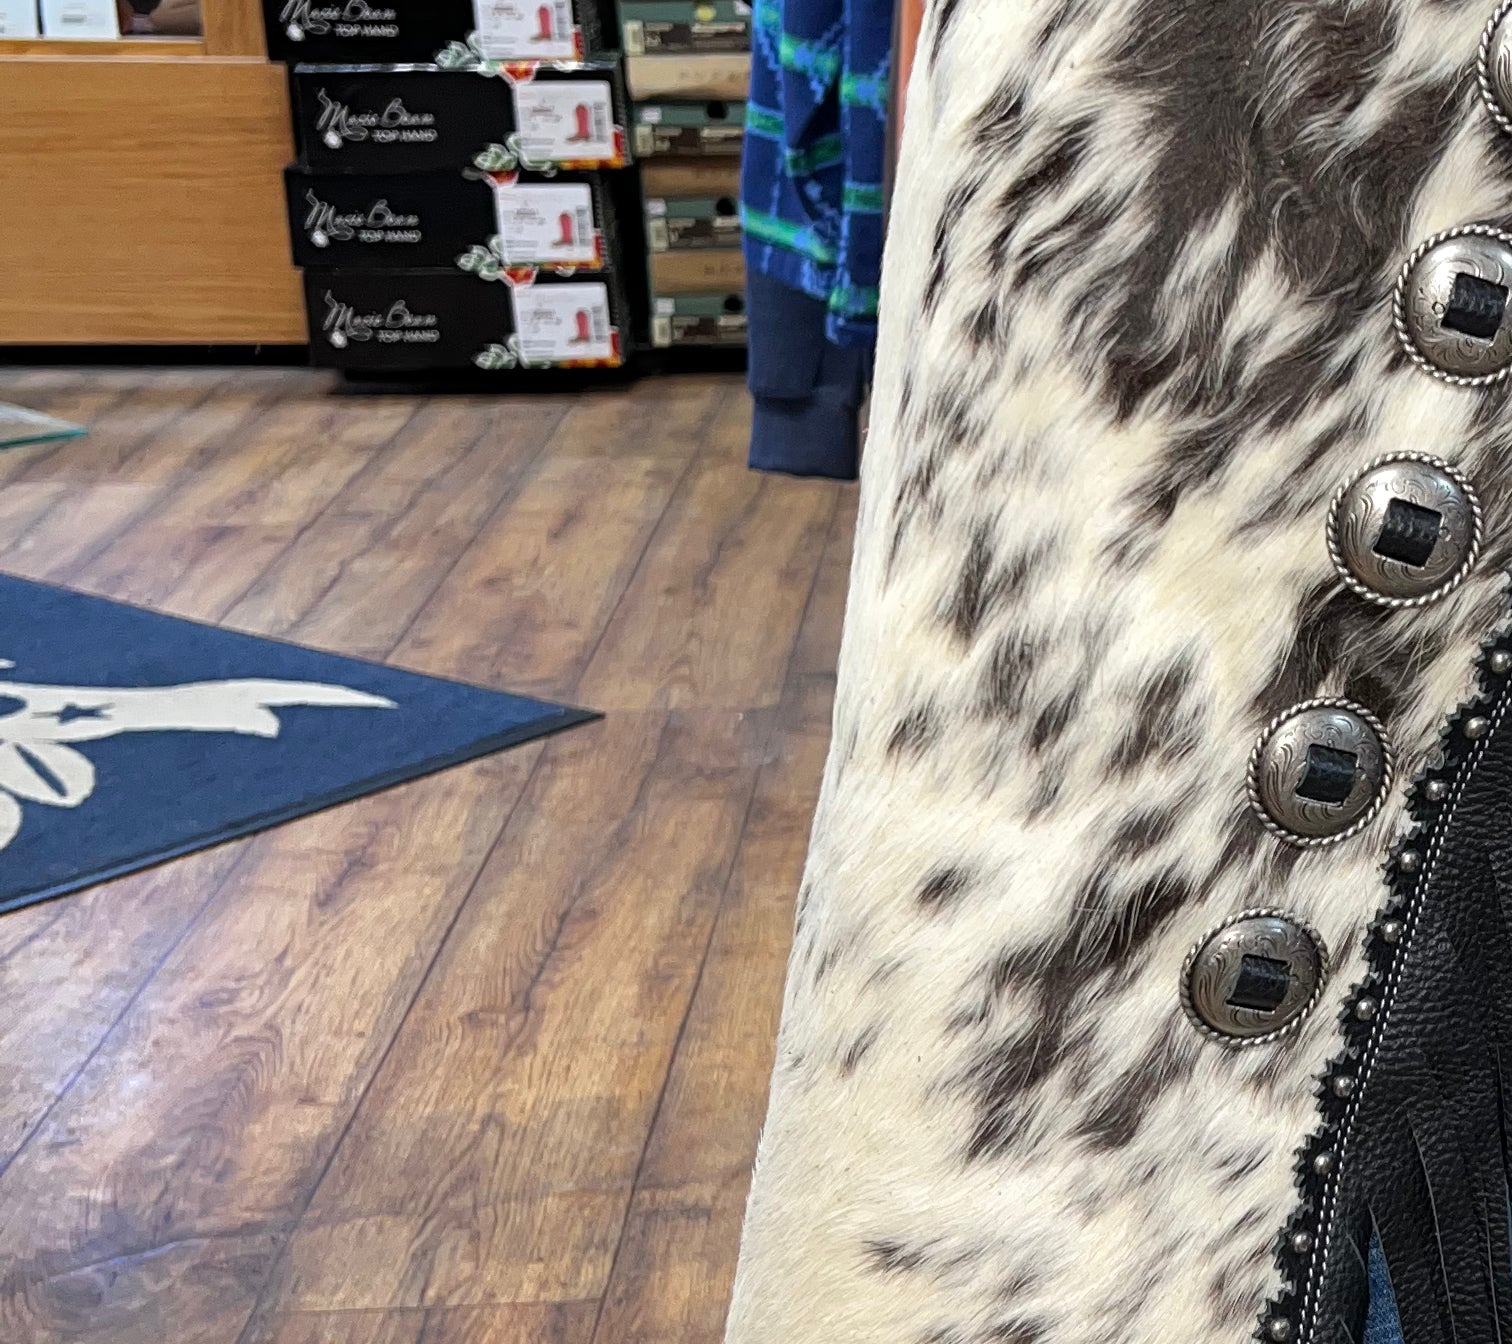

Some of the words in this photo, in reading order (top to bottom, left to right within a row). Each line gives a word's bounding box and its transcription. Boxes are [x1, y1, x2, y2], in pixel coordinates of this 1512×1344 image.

[335, 23, 360, 37] TOP
[360, 23, 399, 38] HAND
[372, 129, 400, 143] TOP
[400, 129, 438, 143] HAND
[358, 229, 383, 243] TOP
[384, 229, 422, 243] HAND
[376, 329, 402, 343] TOP
[402, 329, 440, 343] HAND
